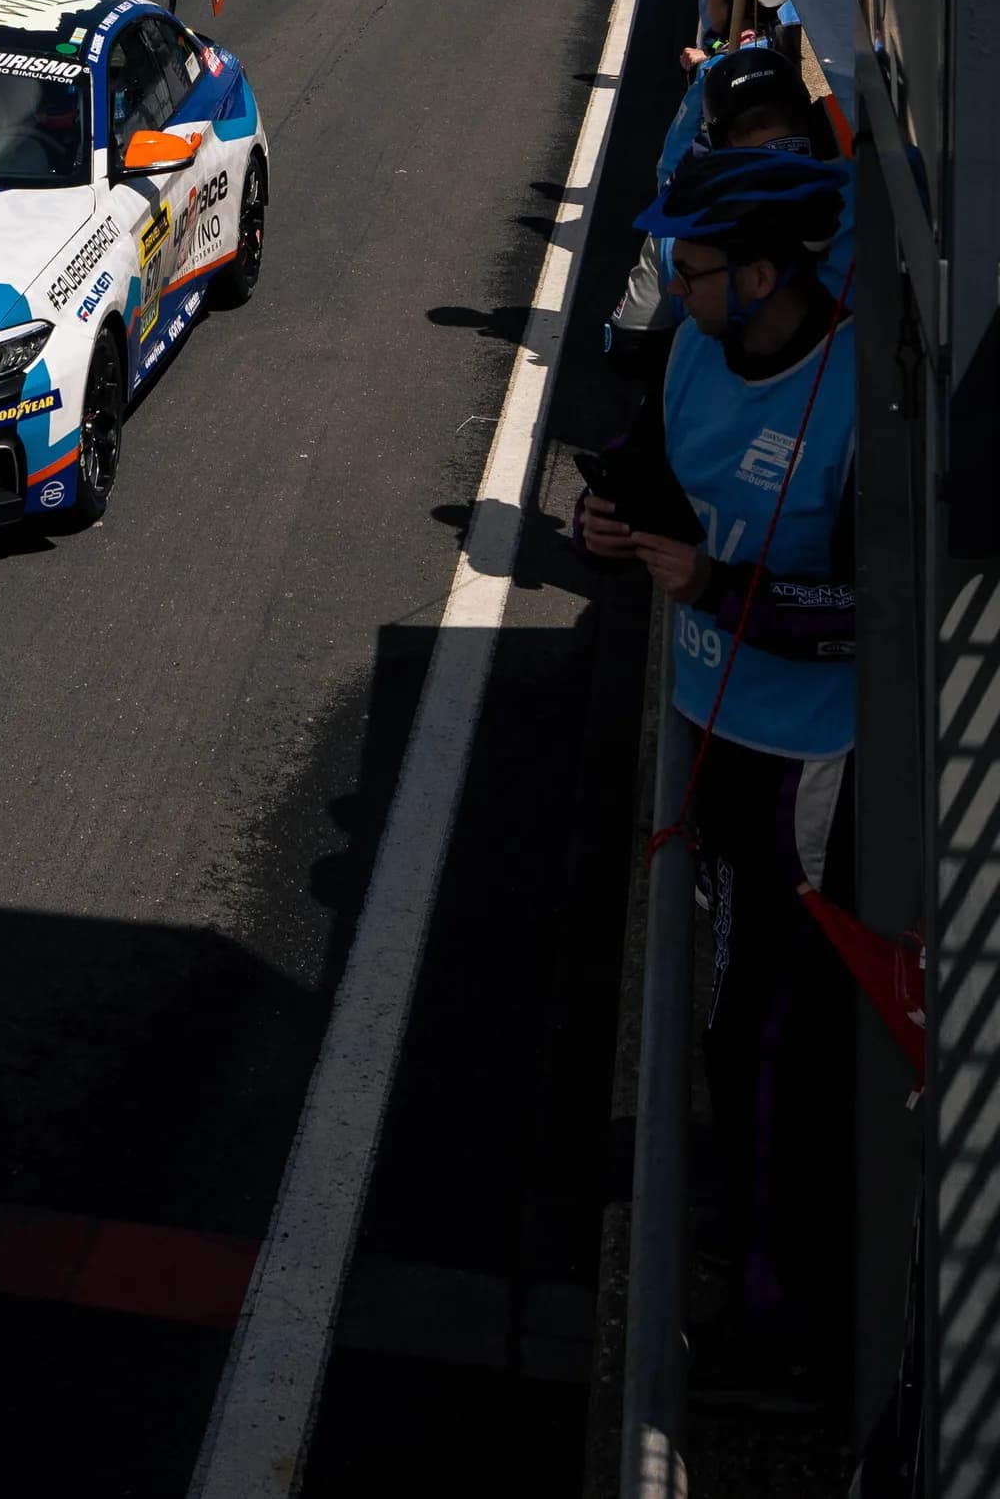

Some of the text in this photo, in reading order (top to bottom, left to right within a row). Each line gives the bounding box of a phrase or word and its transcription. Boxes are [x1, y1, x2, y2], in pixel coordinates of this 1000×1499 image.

[11, 68, 73, 85] SIMULATOR
[76, 270, 114, 323] FALKEN
[676, 609, 722, 669] 199
